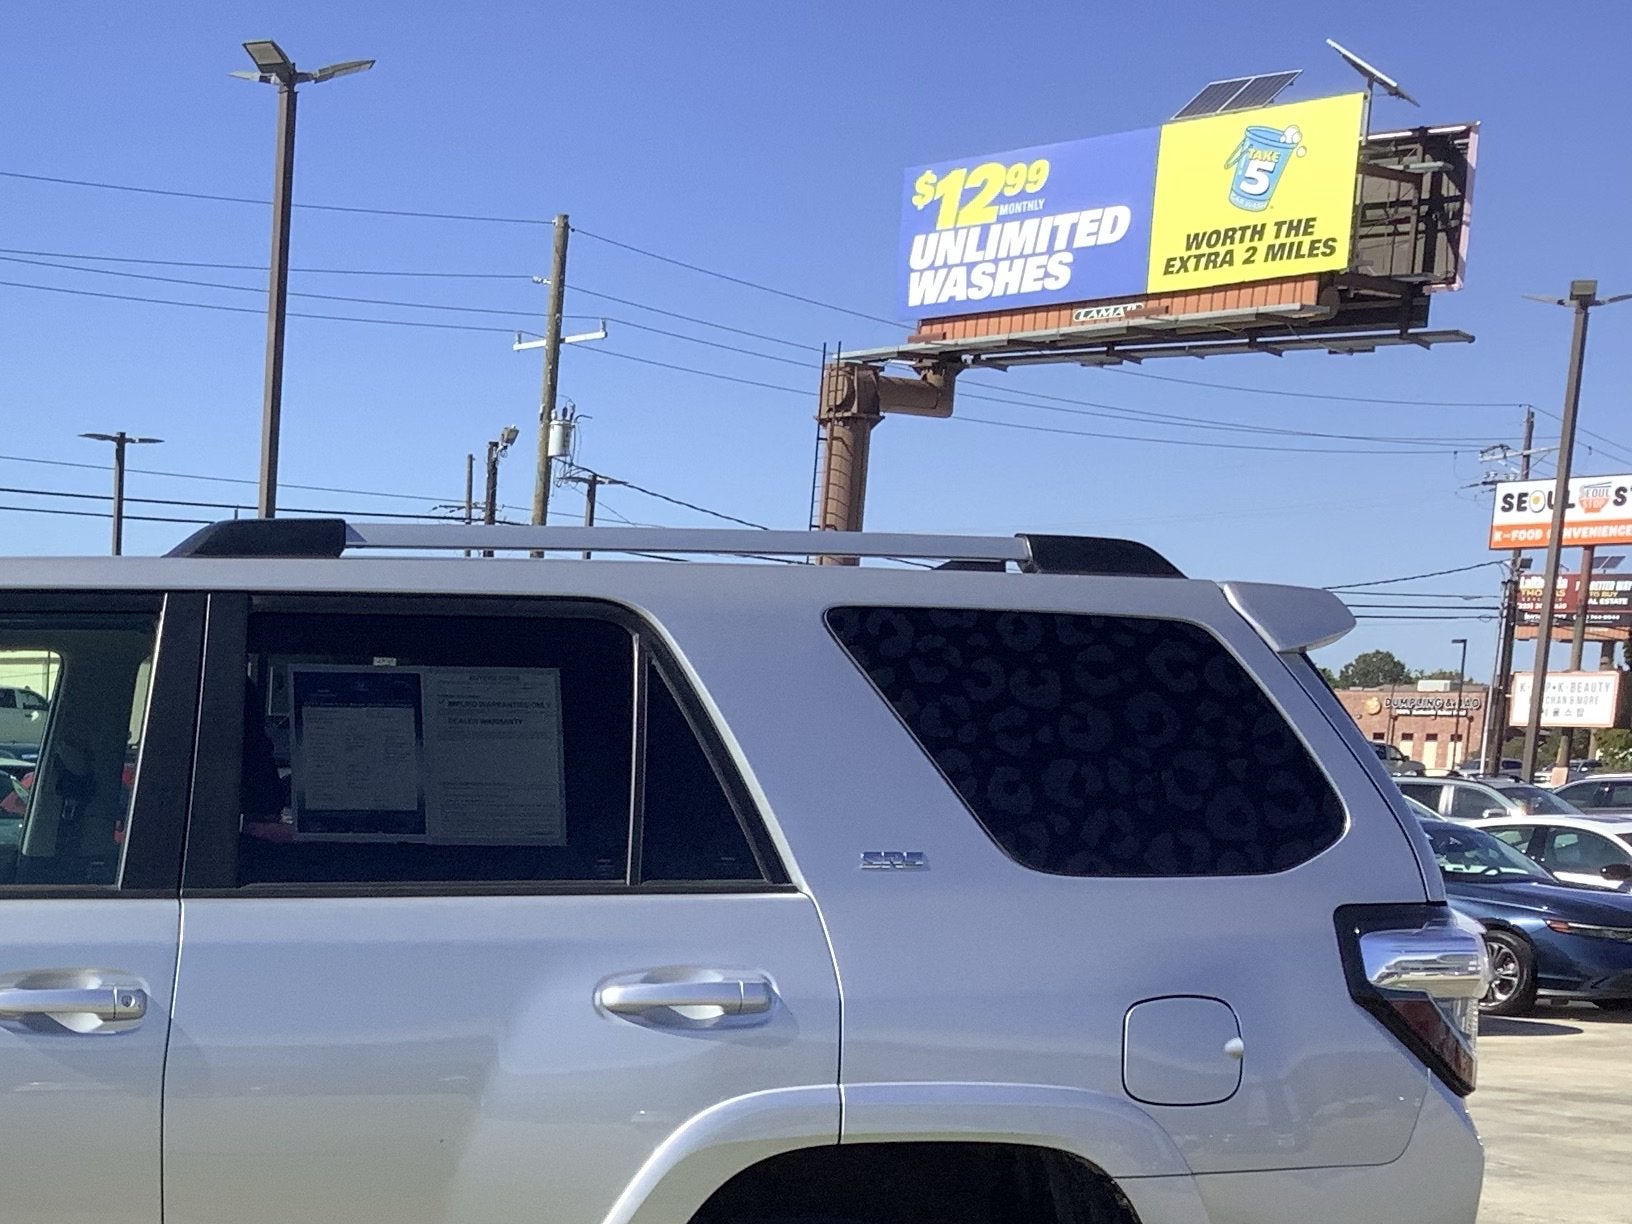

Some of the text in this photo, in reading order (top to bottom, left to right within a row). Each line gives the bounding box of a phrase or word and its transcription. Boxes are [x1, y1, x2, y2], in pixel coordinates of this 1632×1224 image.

[1248, 148, 1281, 163] TAKE
[1239, 159, 1277, 196] 5
[999, 198, 1046, 216] MONTHLY
[909, 205, 1131, 270] UNLIMITED
[1185, 217, 1317, 252] WORTH THE
[1163, 237, 1338, 276] EXTRA 2 MILES
[908, 252, 1074, 307] WASHES
[1385, 697, 1444, 710] DUMPLING
